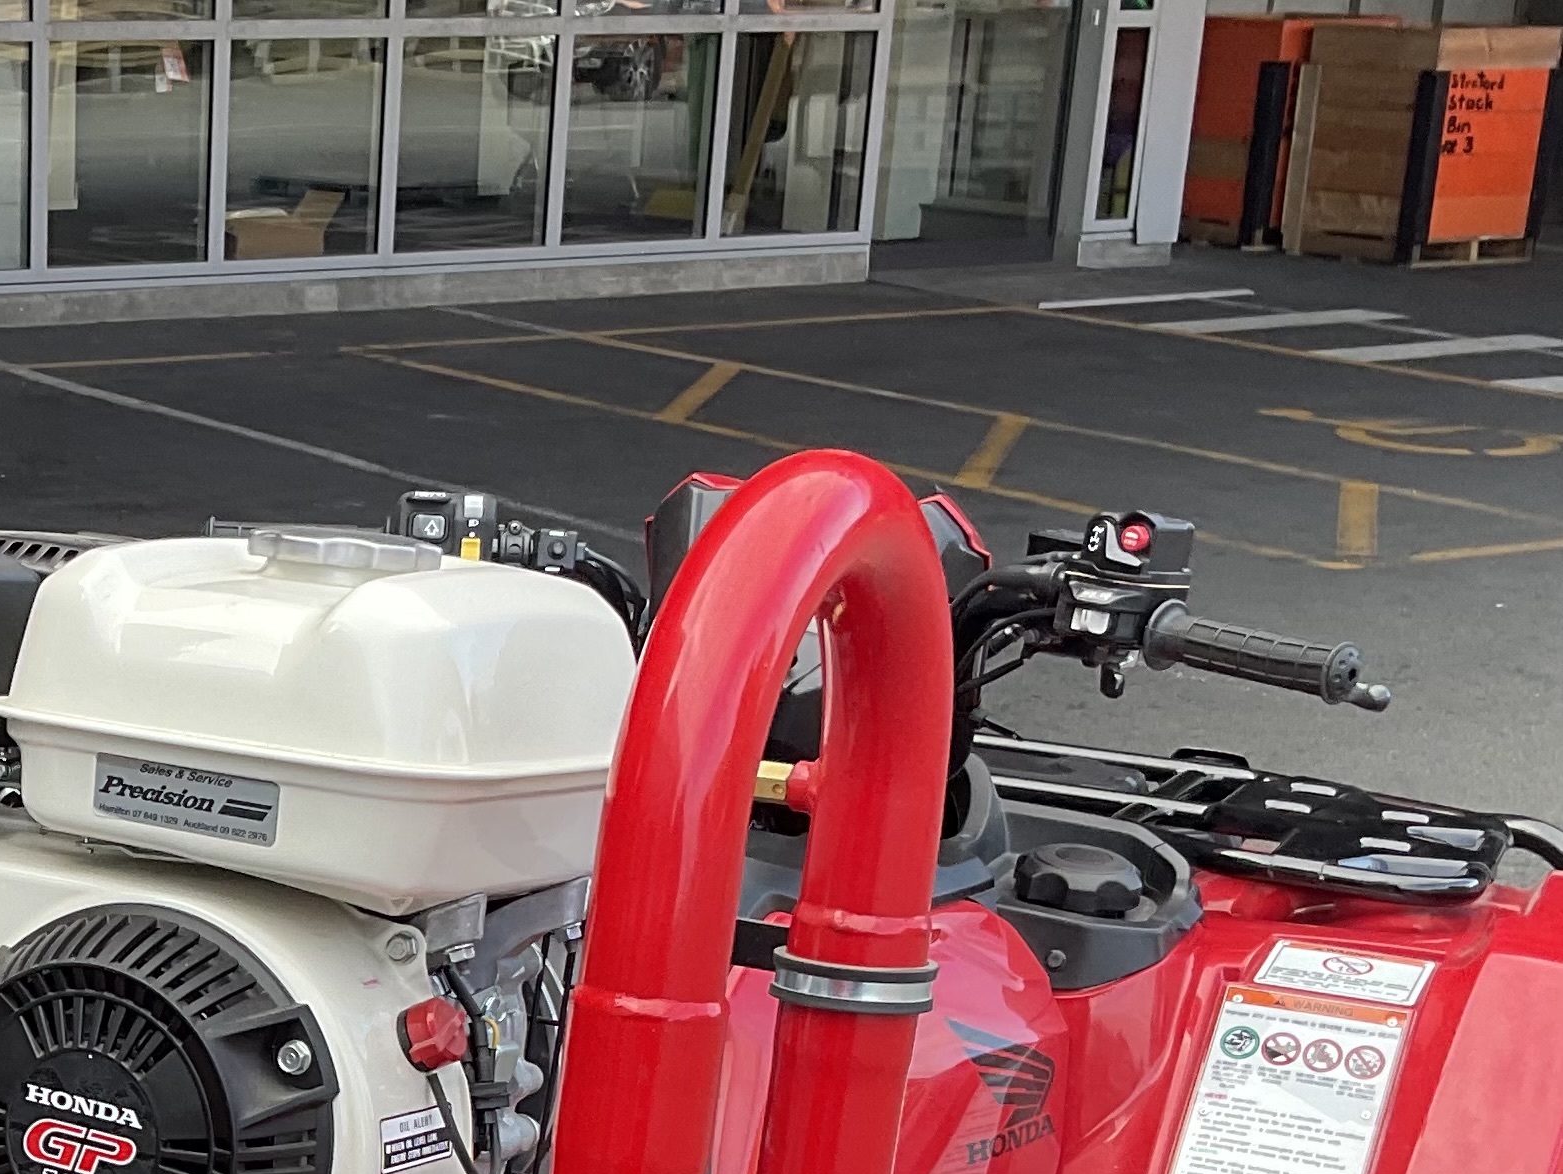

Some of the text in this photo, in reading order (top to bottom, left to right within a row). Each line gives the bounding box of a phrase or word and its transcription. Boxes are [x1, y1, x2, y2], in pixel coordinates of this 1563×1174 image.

[1447, 115, 1471, 133] Bin
[1462, 136, 1474, 153] 3
[140, 763, 233, 788] Sales & Service
[99, 775, 214, 812] Precision
[183, 819, 218, 832] Auckland
[1293, 1000, 1354, 1017] WARNING
[25, 1083, 143, 1130] HONDA
[399, 1114, 433, 1133] OIL ALERT
[966, 1114, 1055, 1164] HONDA
